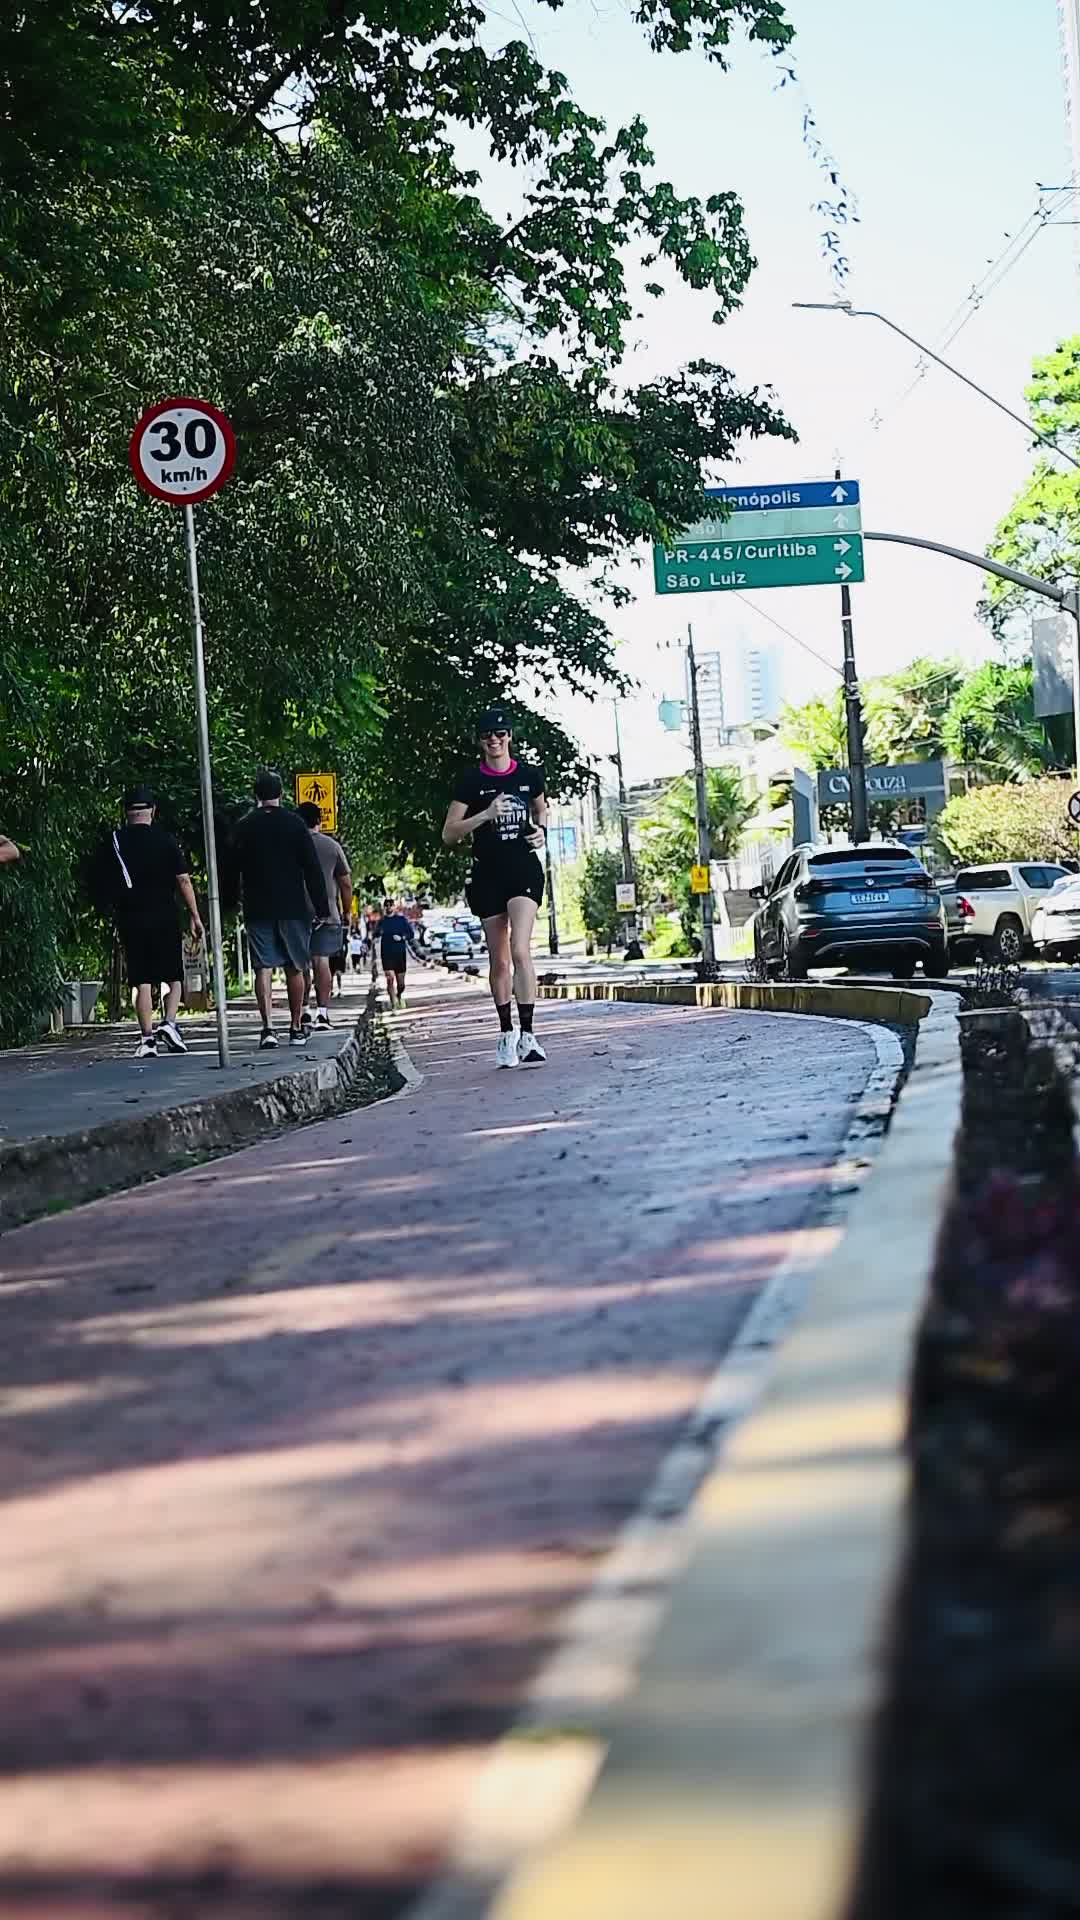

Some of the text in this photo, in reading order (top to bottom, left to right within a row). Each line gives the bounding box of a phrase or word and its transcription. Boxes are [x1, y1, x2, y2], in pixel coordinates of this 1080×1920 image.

[149, 418, 217, 462] 30
[160, 466, 208, 484] km/h
[664, 543, 817, 564] PR-445/Curitiba
[666, 570, 747, 589] São Luiz
